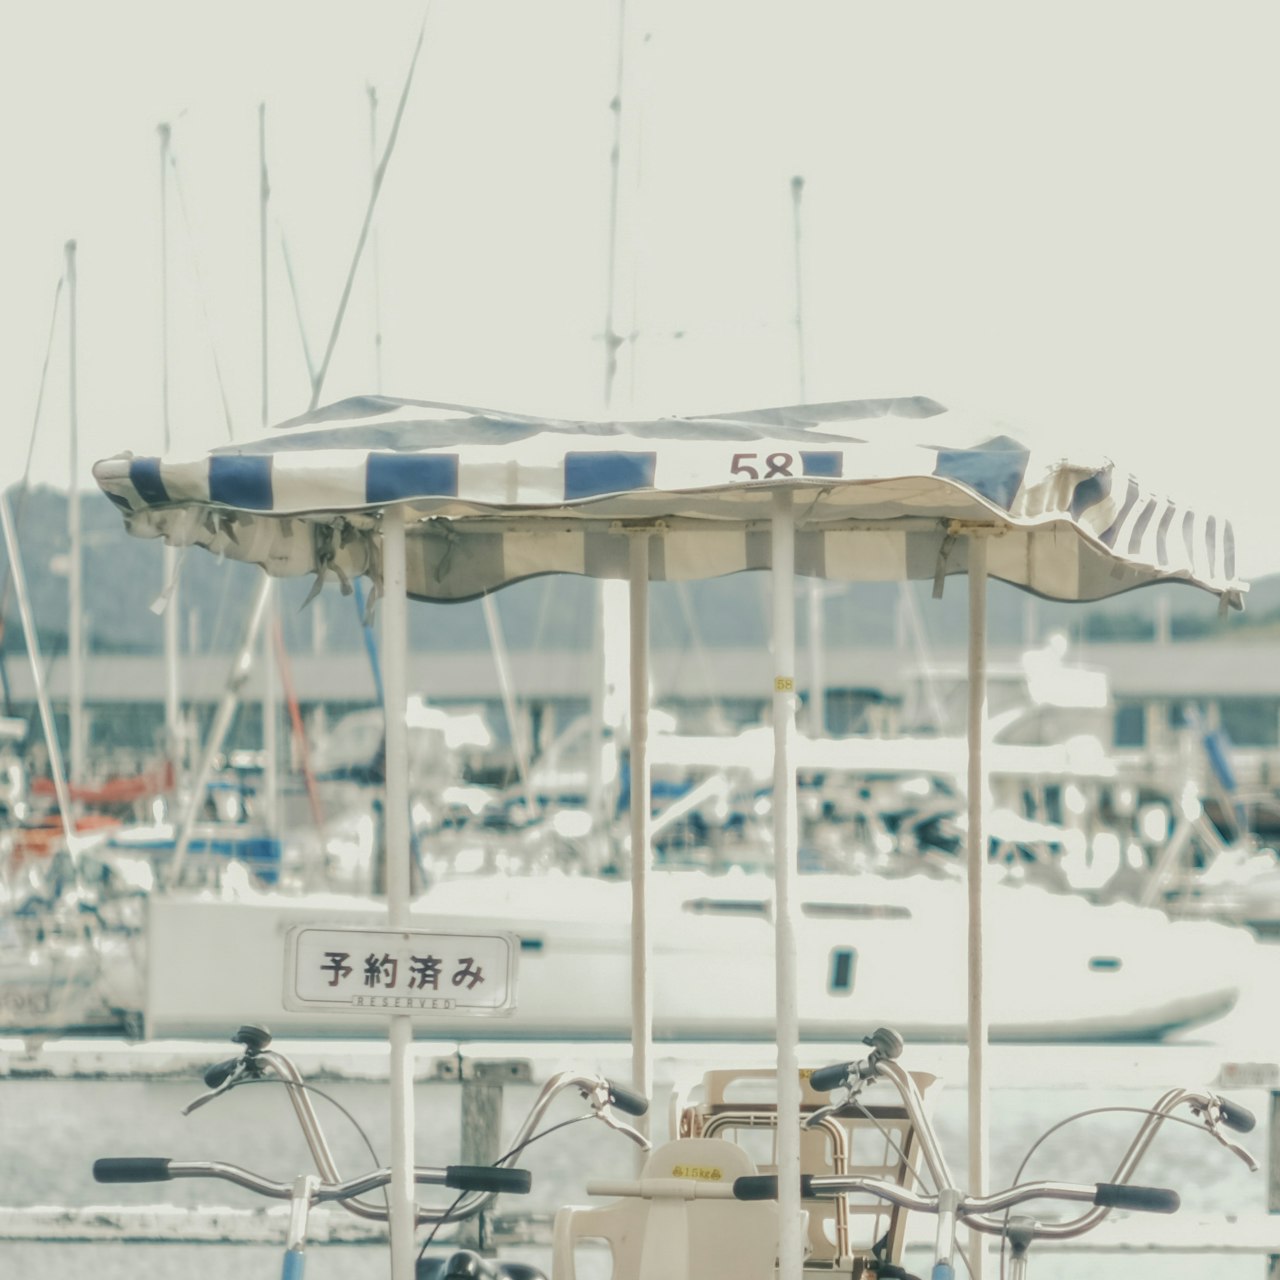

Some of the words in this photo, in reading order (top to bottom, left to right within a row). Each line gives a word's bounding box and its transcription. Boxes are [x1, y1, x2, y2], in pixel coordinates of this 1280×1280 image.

[776, 678, 793, 690] 58
[320, 952, 485, 990] 予約済み
[356, 996, 451, 1010] RESERVED
[685, 1167, 711, 1179] 15kg
